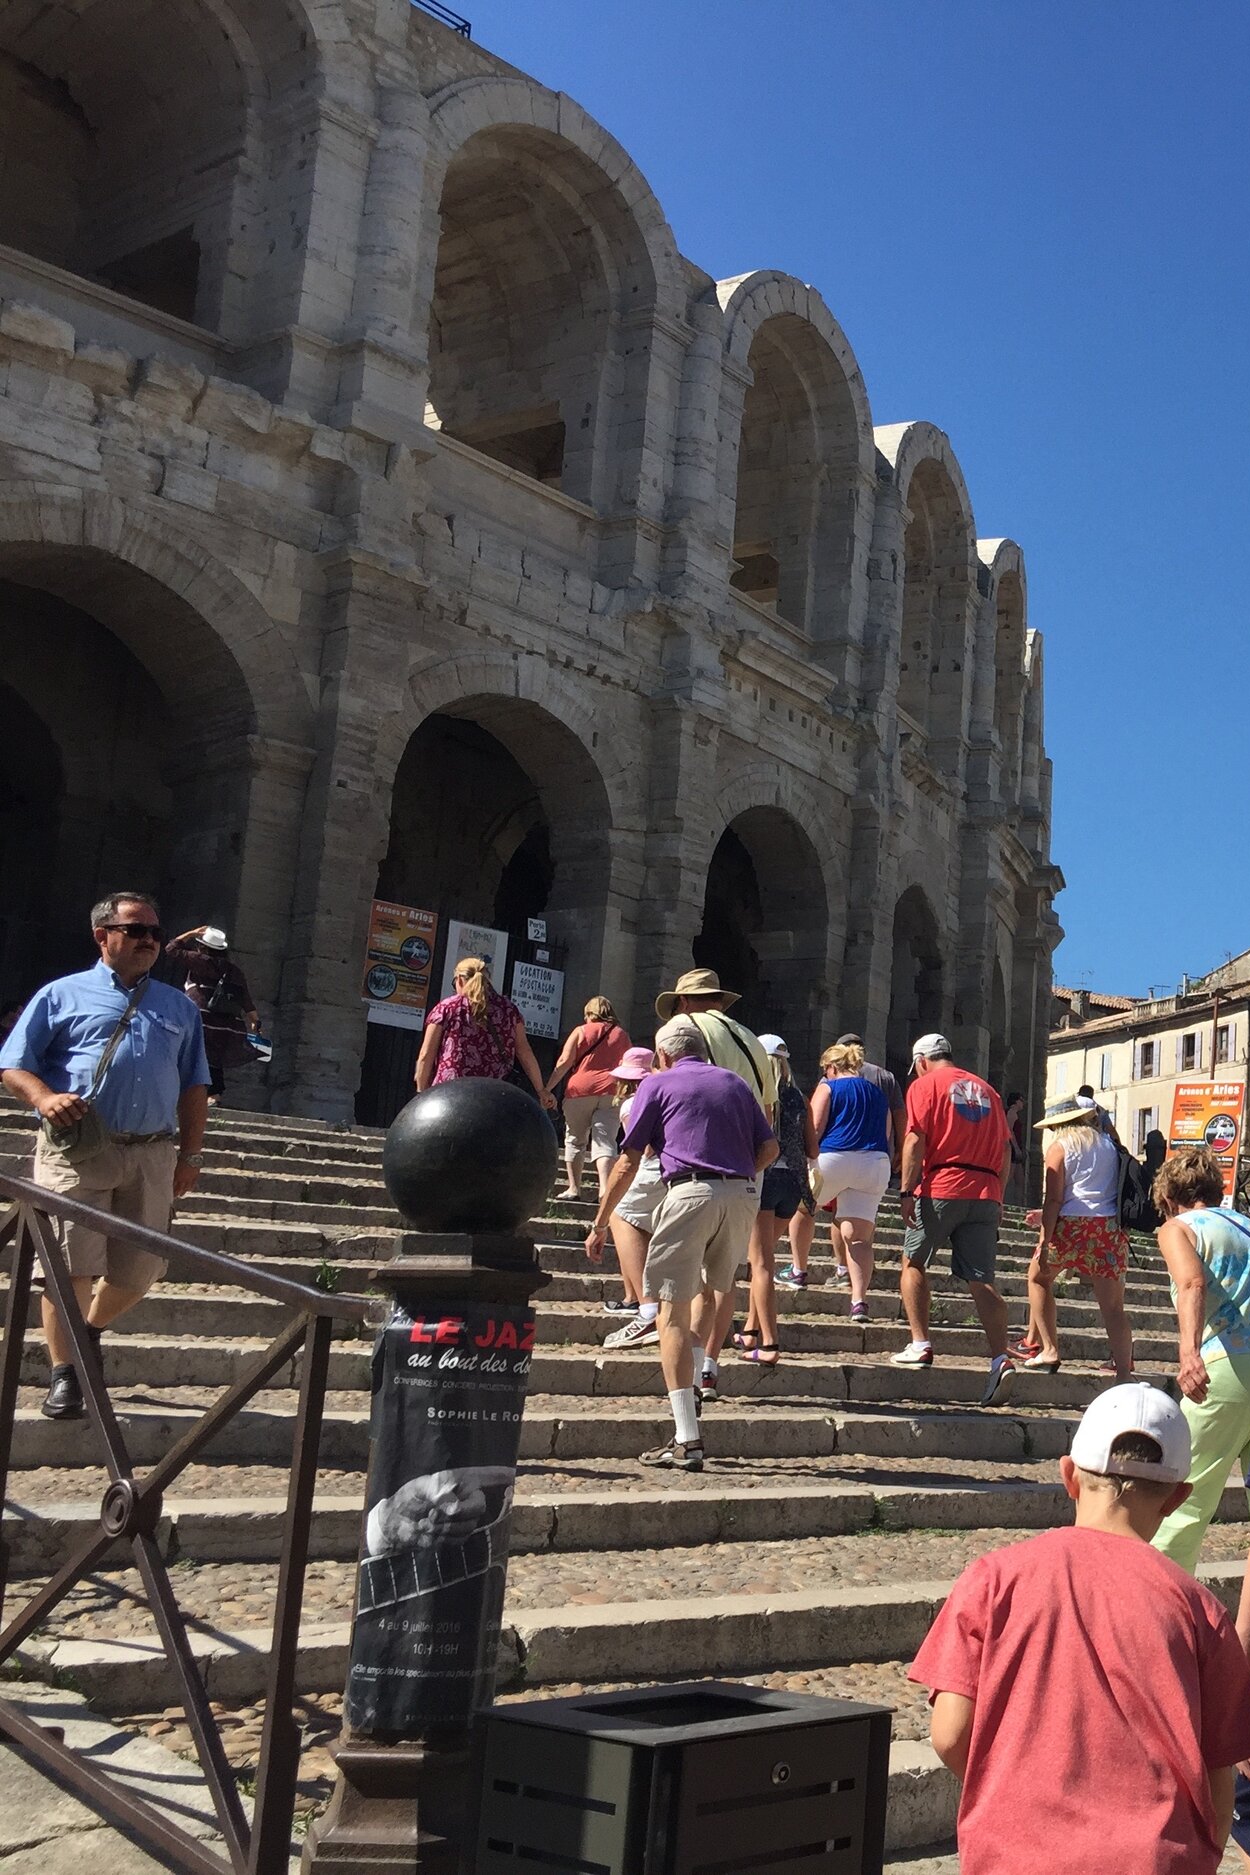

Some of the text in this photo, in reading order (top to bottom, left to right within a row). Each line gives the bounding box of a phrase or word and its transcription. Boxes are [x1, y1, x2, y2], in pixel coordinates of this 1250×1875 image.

[409, 910, 434, 923] Arles
[520, 965, 553, 981] LOCATION
[1213, 1085, 1240, 1095] Arles
[410, 1315, 464, 1345] LE
[407, 1352, 433, 1368] au
[438, 1347, 479, 1370] bout
[480, 1352, 508, 1372] des
[378, 1618, 386, 1629] 4
[402, 1620, 409, 1631] 9
